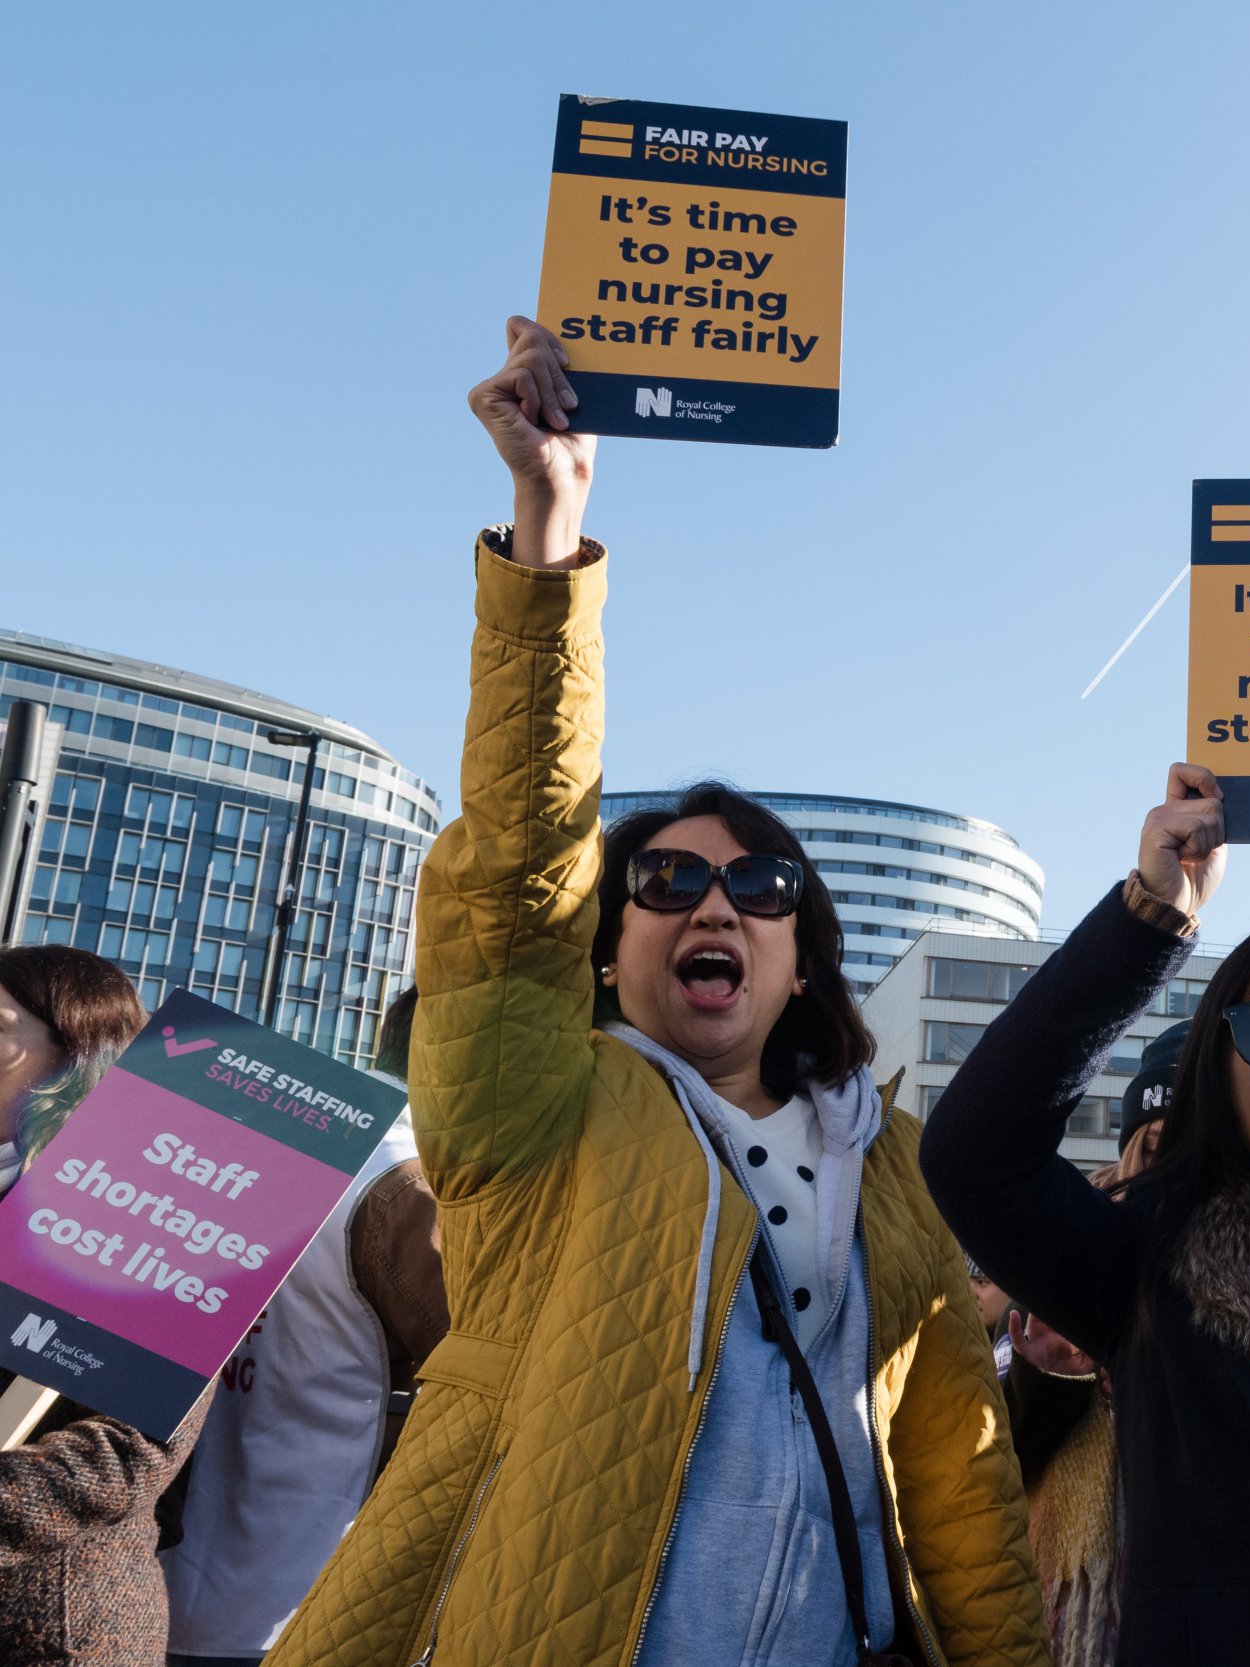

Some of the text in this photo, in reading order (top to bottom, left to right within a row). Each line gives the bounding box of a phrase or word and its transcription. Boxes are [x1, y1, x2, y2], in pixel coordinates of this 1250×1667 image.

[645, 126, 768, 152] FAIR PAY
[645, 145, 828, 176] FOR NURSING
[600, 195, 798, 237] It’s time
[619, 237, 773, 280] to pay
[598, 279, 788, 321] nursing
[560, 314, 819, 362] staff fairly
[675, 410, 722, 423] of Nursing
[676, 400, 736, 414] Royal College
[205, 1064, 333, 1130] SAVES LIVES
[217, 1049, 375, 1129] SAFE STAFFING
[142, 1132, 260, 1201] Staff
[55, 1157, 271, 1271] shortages
[28, 1208, 229, 1314] cost lives
[43, 1350, 85, 1376] of Nursing
[51, 1338, 104, 1368] Royal College
